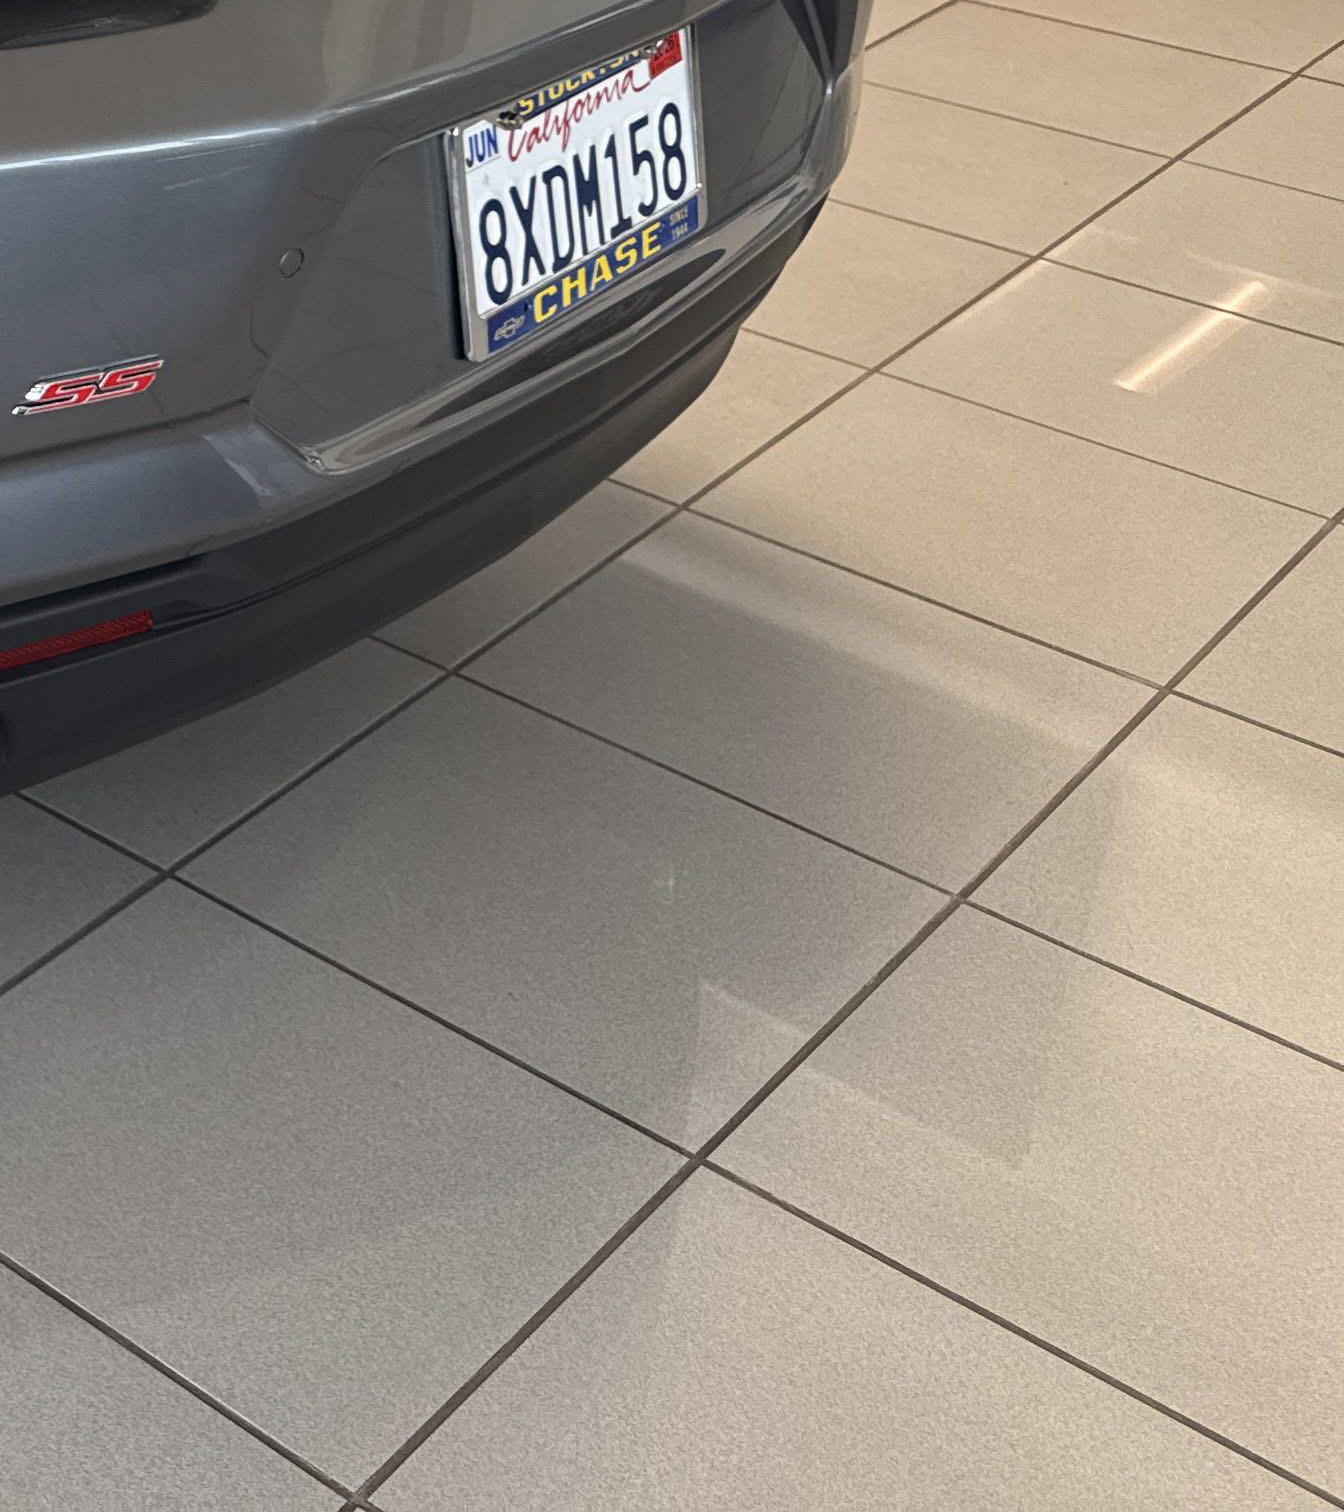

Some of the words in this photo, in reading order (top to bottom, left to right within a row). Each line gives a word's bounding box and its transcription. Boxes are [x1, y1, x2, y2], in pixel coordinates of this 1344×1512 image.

[507, 68, 654, 162] California
[519, 49, 641, 116] STOC
[466, 123, 499, 168] JUN
[479, 102, 688, 306] 8XDM158
[533, 221, 664, 324] CHASE
[12, 359, 165, 416] SS
